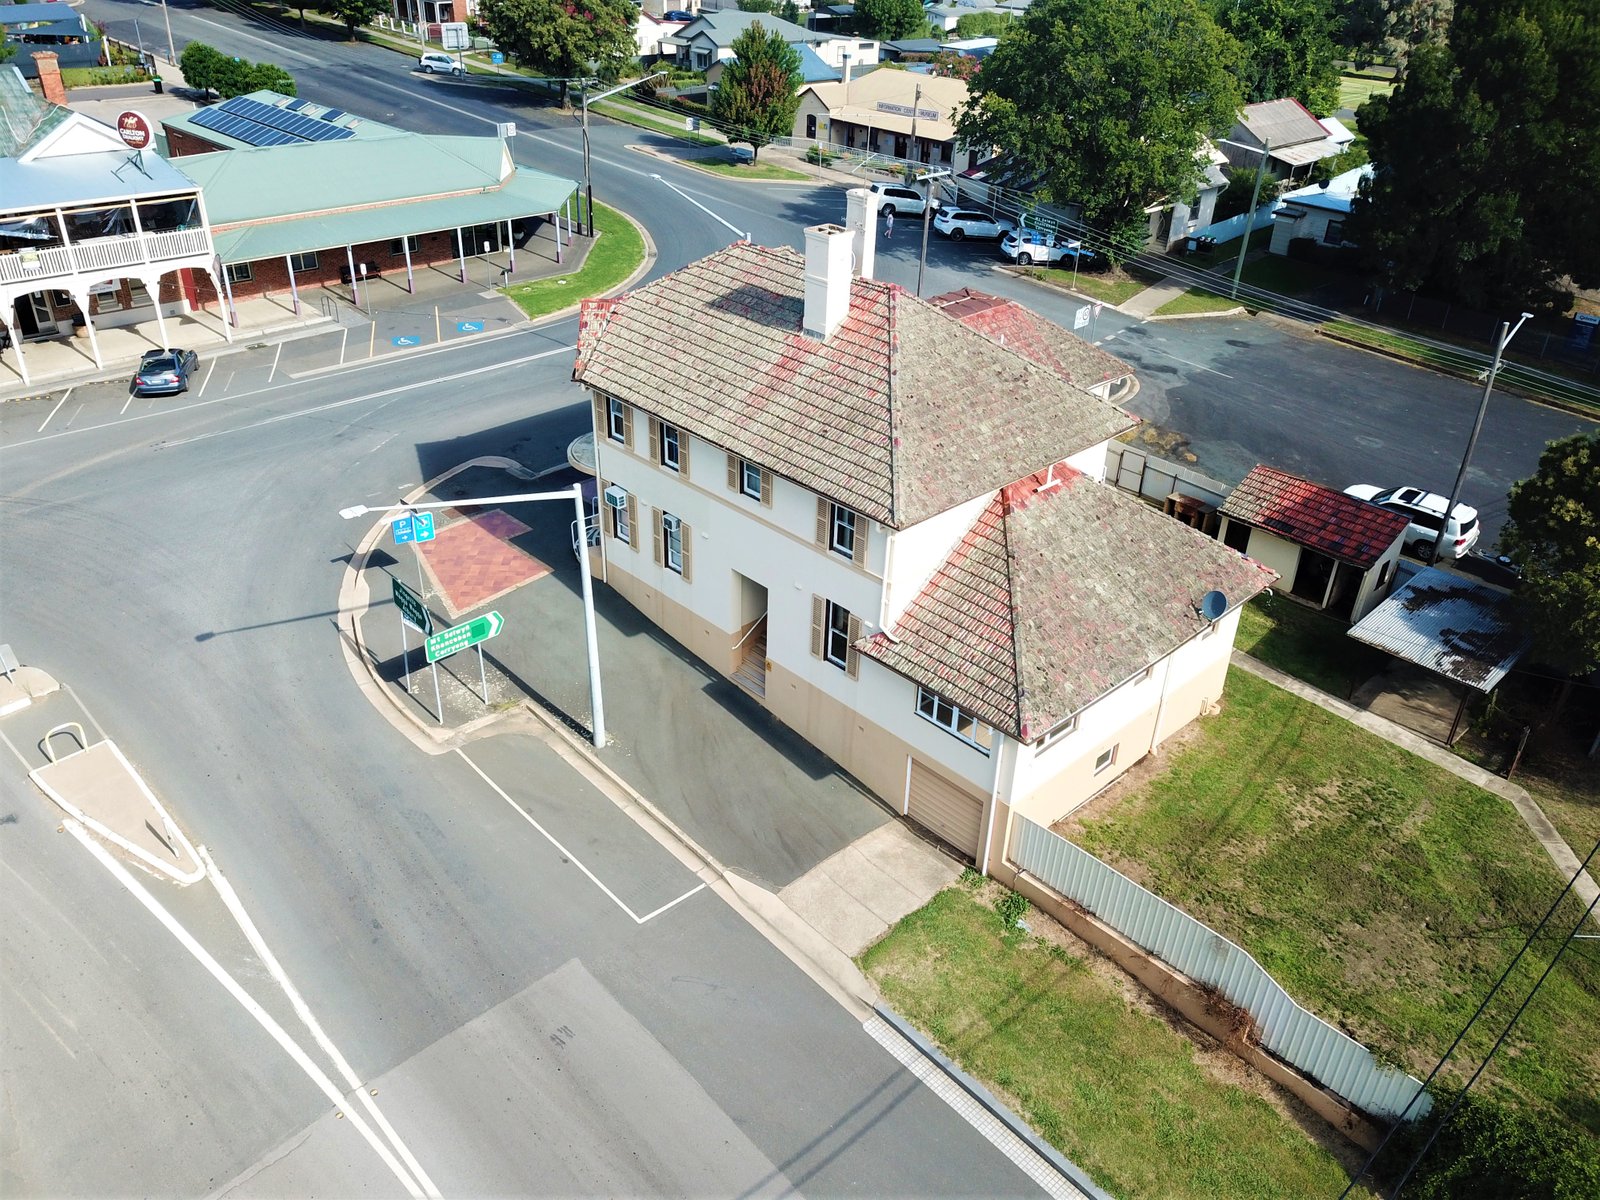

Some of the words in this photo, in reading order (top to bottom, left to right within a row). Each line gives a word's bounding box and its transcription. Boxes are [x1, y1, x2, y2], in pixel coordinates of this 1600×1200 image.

[120, 128, 145, 137] CARLTON
[430, 636, 441, 645] Mt
[444, 624, 470, 639] Selwyn
[431, 632, 472, 652] Khancoban
